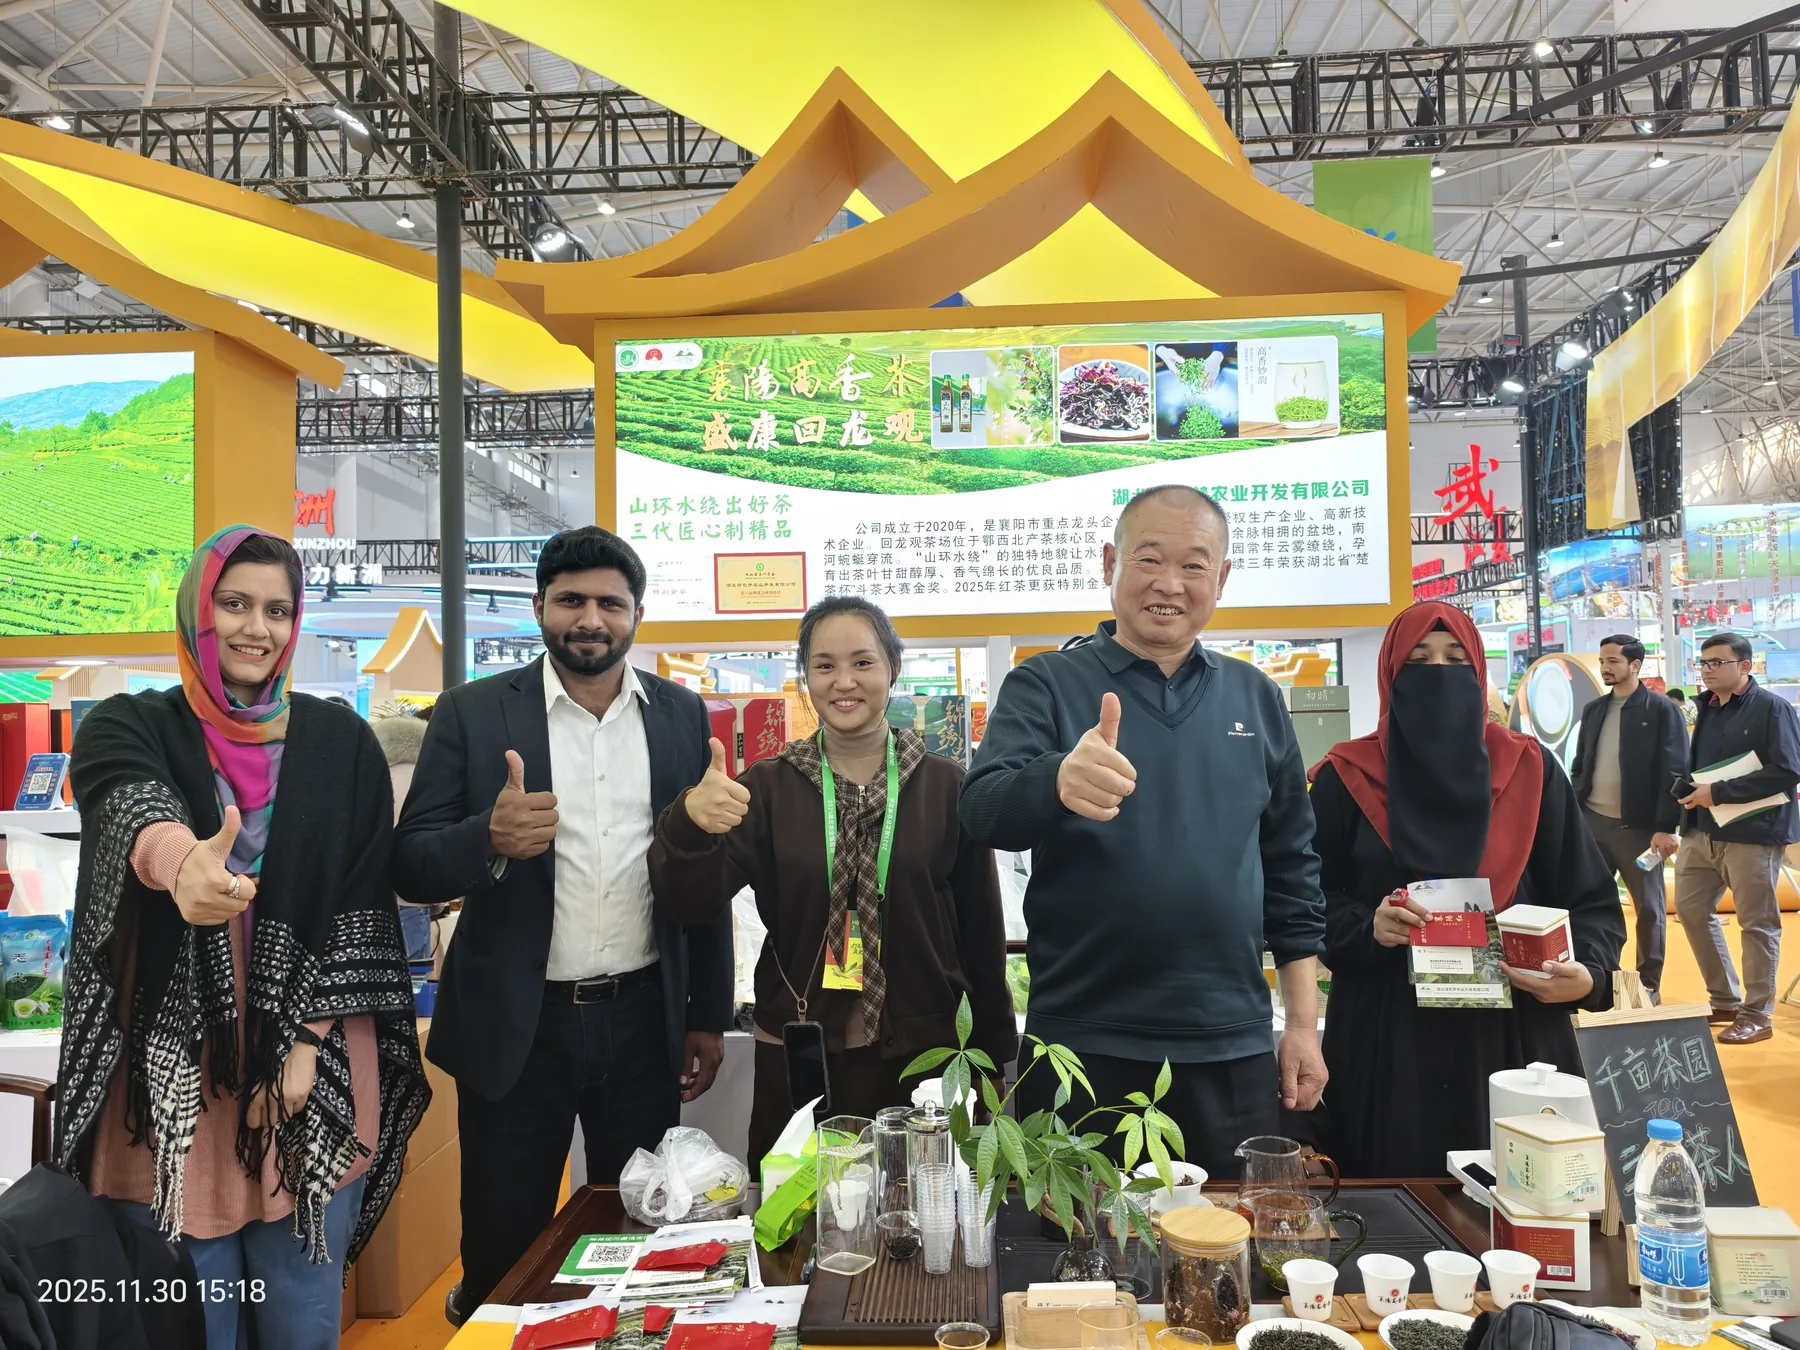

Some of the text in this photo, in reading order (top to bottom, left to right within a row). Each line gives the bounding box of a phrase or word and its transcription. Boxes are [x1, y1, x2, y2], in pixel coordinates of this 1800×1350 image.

[1194, 479, 1369, 502] 农业开发有限公司
[629, 494, 793, 516] 山环水绕出好茶
[630, 519, 792, 542] 三代匠心制精品
[855, 516, 1120, 535] 公司成立于2020年，是襄阳市重点龙头企
[1231, 522, 1365, 540] 余脉相拥的盆地，南
[293, 538, 357, 550] XINZHOU
[1231, 537, 1366, 554] 园常年云雾缭绕，孕
[824, 561, 1104, 581] 育出茶叶甘甜醇厚、香气绵长的优良品质。
[1594, 1034, 1713, 1114] 千亩茶园
[1618, 1123, 1751, 1197] 三茶人
